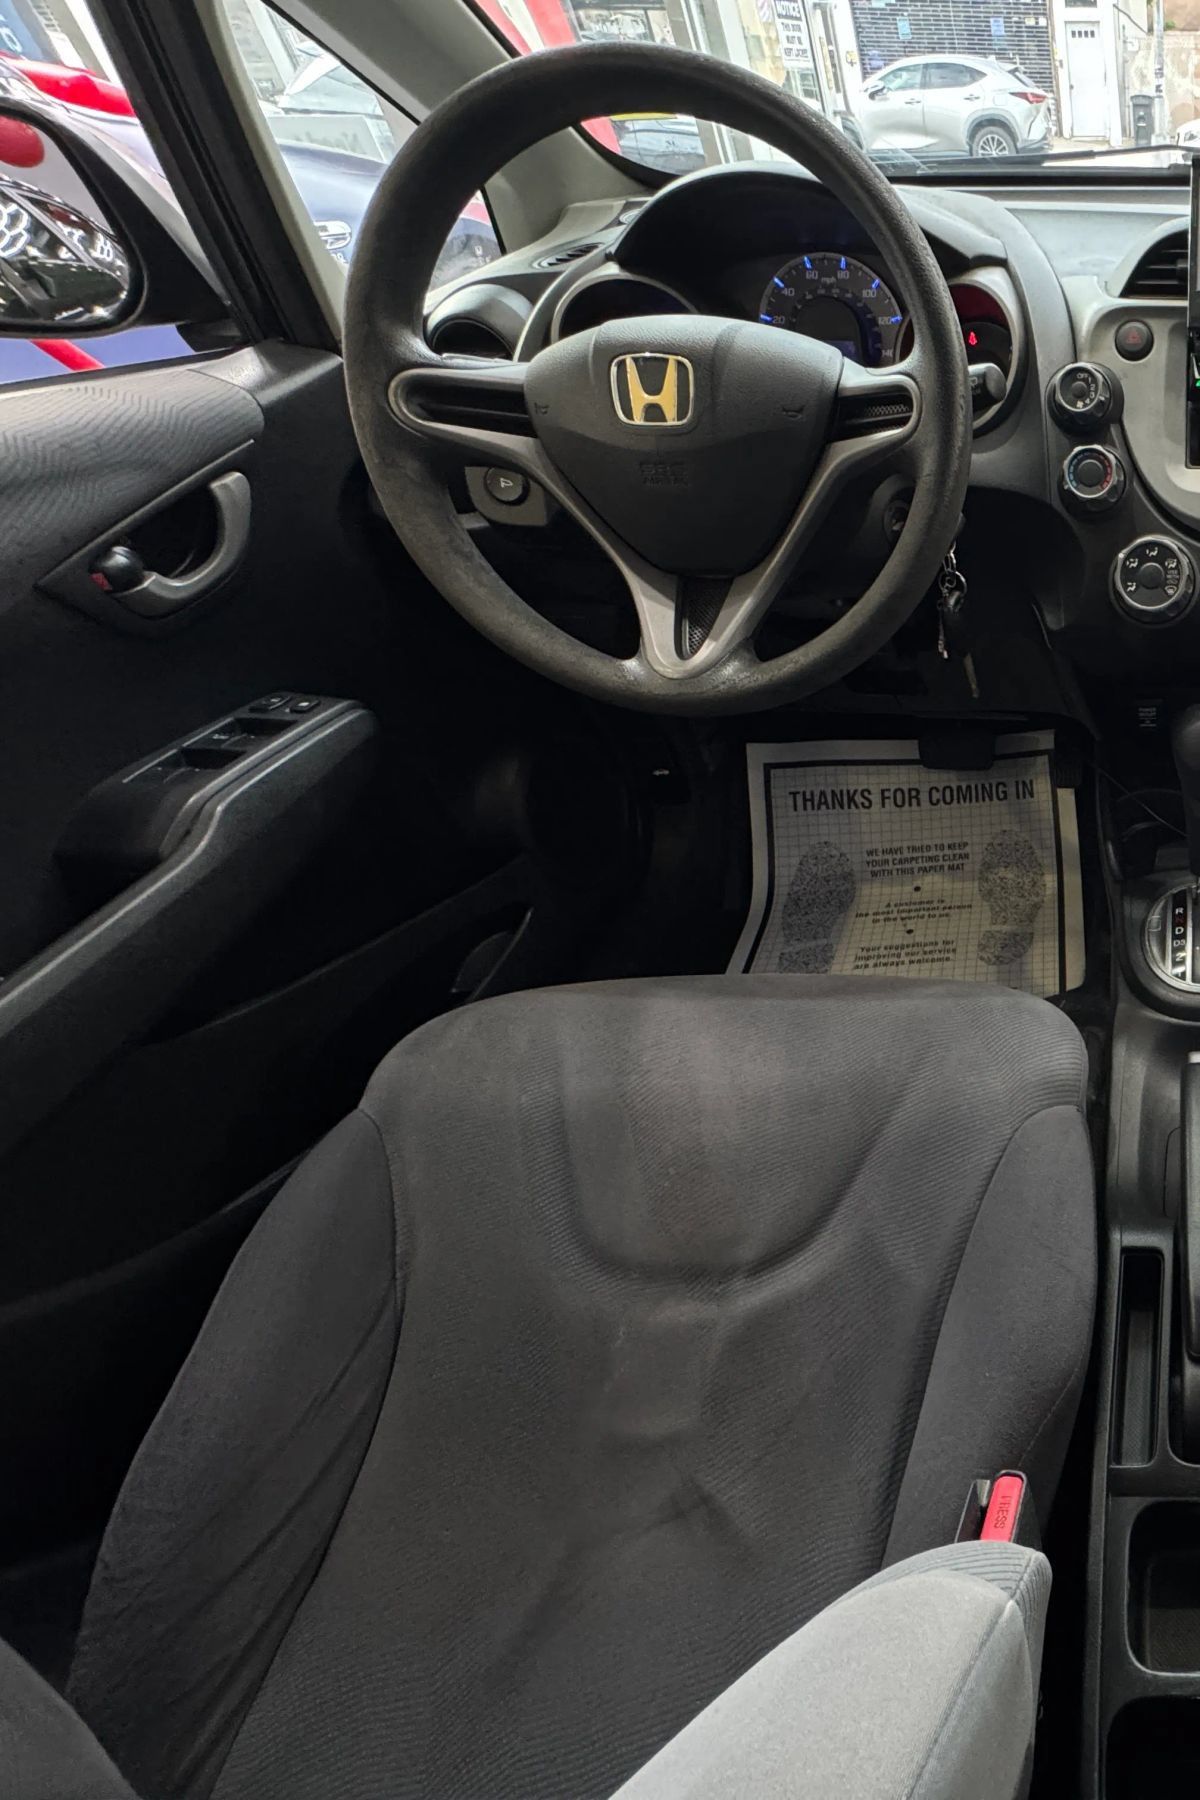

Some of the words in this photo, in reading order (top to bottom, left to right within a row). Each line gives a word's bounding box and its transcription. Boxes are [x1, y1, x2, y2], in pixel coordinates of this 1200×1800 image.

[805, 271, 818, 280] 60
[837, 271, 850, 280] 80
[821, 276, 837, 284] mph
[781, 287, 795, 297] 40
[862, 289, 877, 298] 100
[772, 315, 785, 325] 20
[788, 787, 873, 813] THANKS
[880, 785, 921, 810] FOR
[928, 780, 1009, 806] COMING
[1014, 778, 1035, 800] IN
[866, 848, 881, 857] WE
[881, 846, 904, 856] HAVE
[907, 844, 931, 854] TRIED
[934, 843, 945, 852] TO
[947, 841, 969, 851] KEEP
[866, 858, 890, 868] YOUR
[891, 854, 940, 867] CARPETING
[942, 852, 970, 862] CLEAN
[870, 868, 893, 878] WITH
[896, 866, 915, 876] THIS
[917, 863, 945, 874] PAPER
[947, 862, 965, 872] MAT
[855, 911, 869, 919] the
[872, 909, 894, 917] most
[897, 905, 940, 915] important
[942, 903, 973, 912] person
[1175, 906, 1184, 915] R
[900, 914, 925, 922] world
[1175, 926, 1184, 935] D
[860, 945, 881, 953] Your
[884, 941, 939, 952] suggestions
[1173, 939, 1186, 948] D3
[854, 952, 902, 962] improving
[923, 947, 957, 956] service
[872, 959, 905, 969] always
